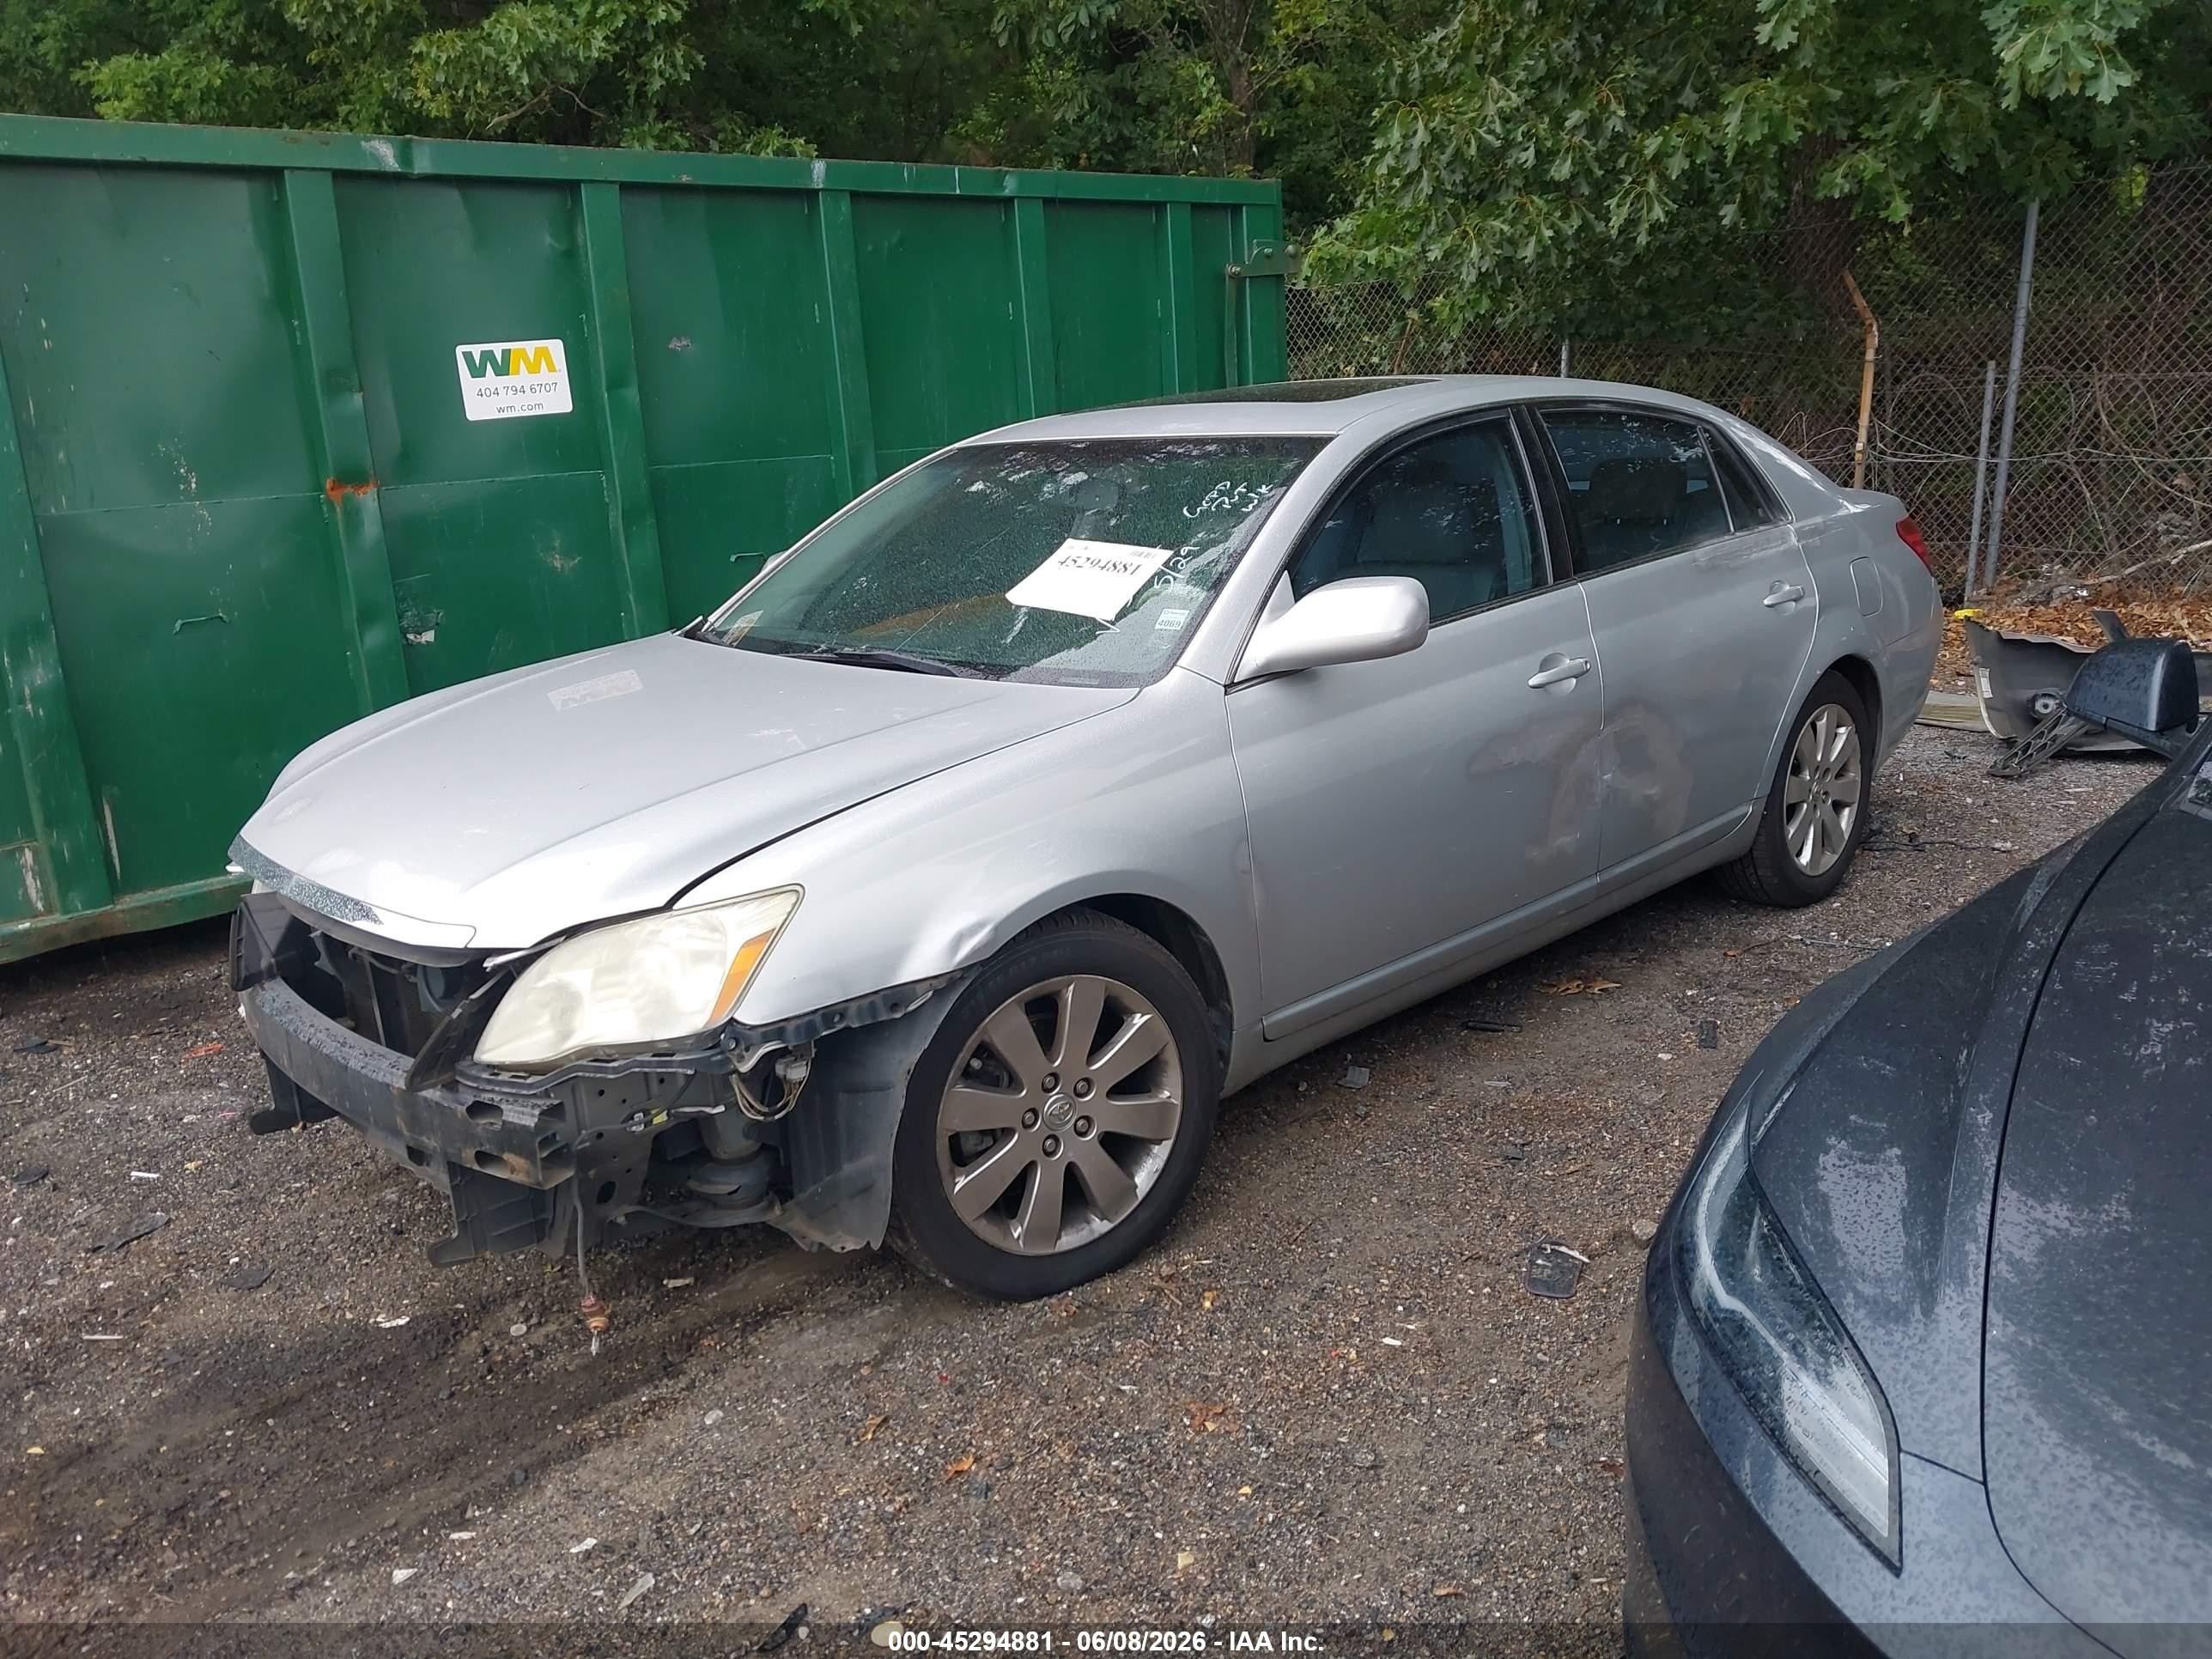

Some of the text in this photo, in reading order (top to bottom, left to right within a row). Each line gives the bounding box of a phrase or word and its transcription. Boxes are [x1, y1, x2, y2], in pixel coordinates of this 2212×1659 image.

[461, 346, 558, 379] WM
[476, 382, 558, 398] 404 794 6707
[495, 402, 544, 414] wm.com
[1058, 556, 1142, 575] 45294881
[1153, 546, 1200, 593] 5/29
[1158, 619, 1182, 629] 4069
